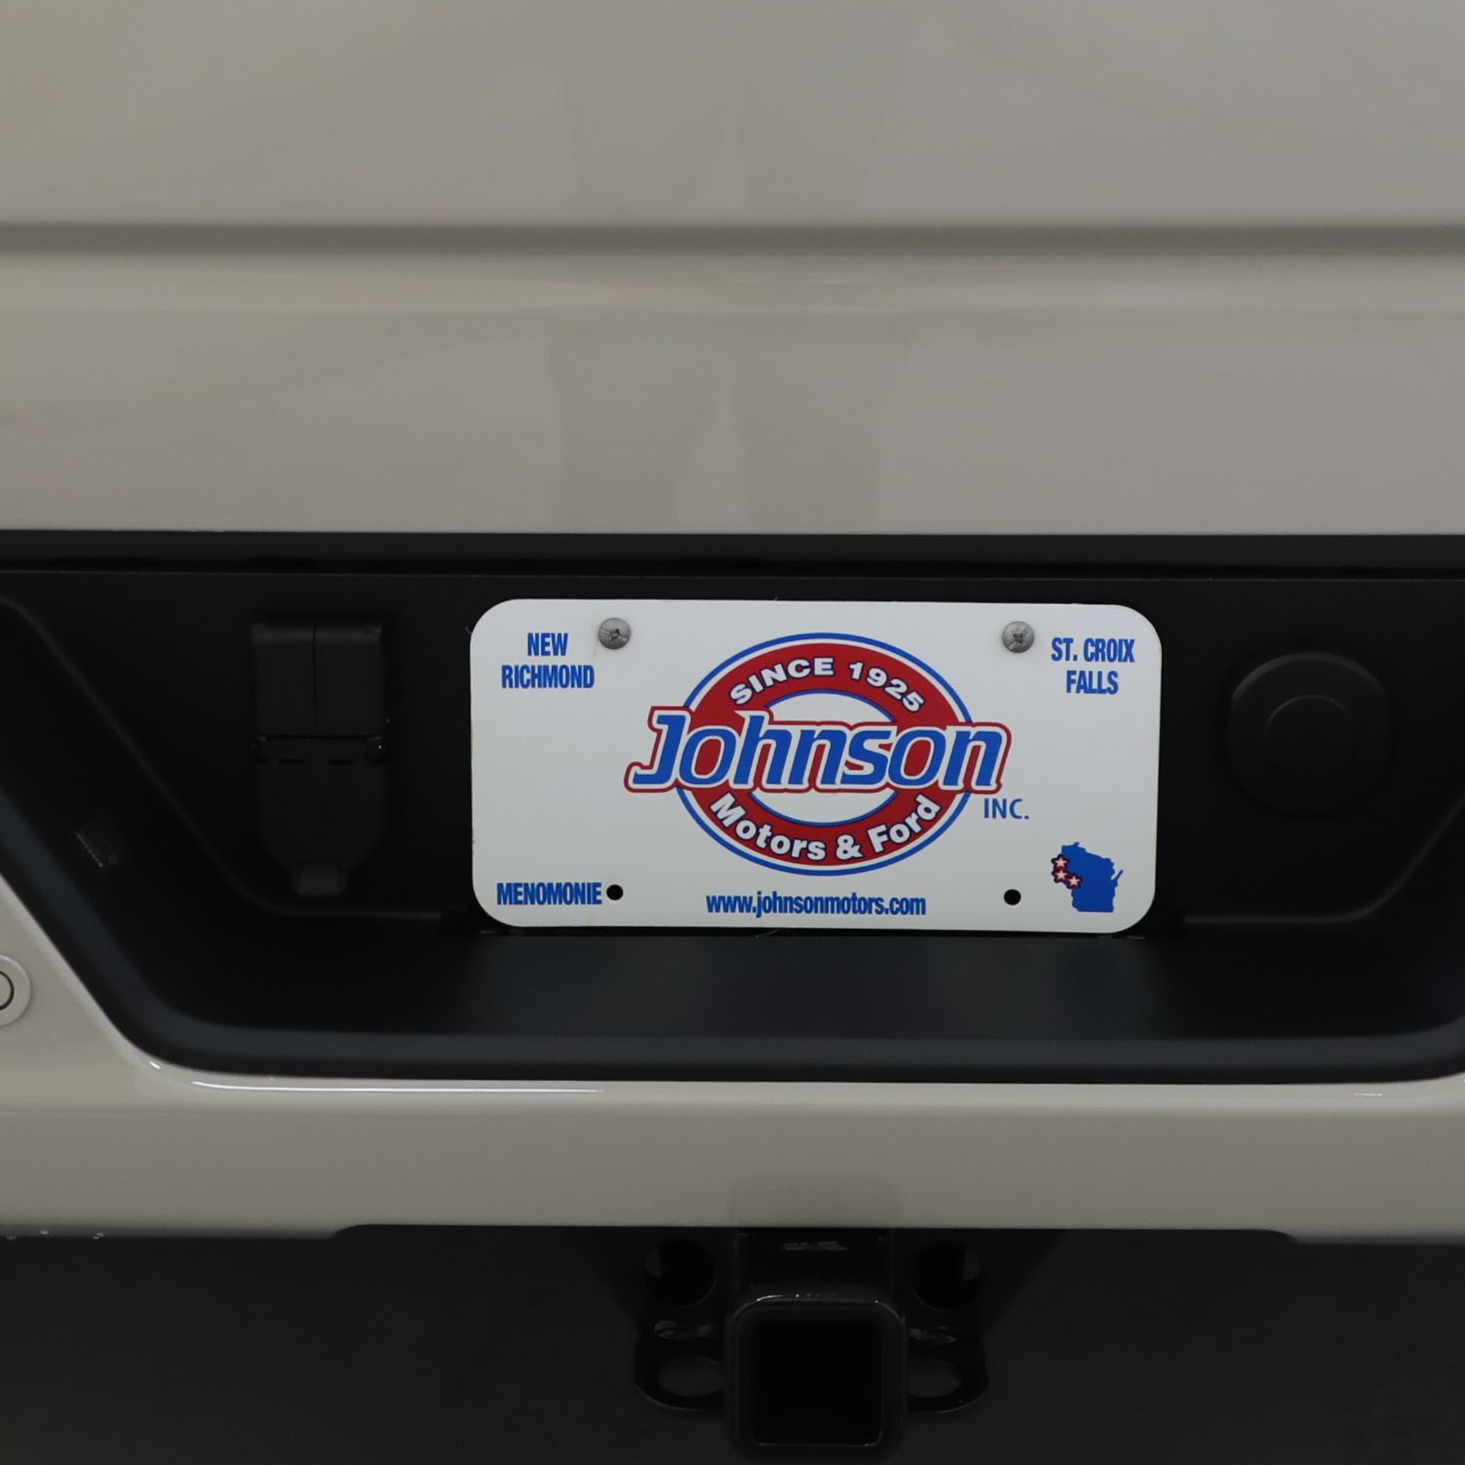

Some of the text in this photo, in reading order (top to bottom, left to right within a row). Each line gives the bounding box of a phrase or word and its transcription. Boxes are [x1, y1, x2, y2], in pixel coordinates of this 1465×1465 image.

[526, 632, 570, 657] NEW
[1050, 637, 1136, 663] ST. CROIX
[500, 664, 596, 689] RICHMOND
[728, 655, 925, 714] SINCE 1925
[1065, 670, 1120, 695] FALLS
[628, 708, 1008, 792] Johnson
[983, 797, 1031, 820] INC.
[709, 792, 941, 862] Motors & Ford
[496, 882, 603, 907] MENOMONIE
[705, 890, 927, 917] www.johnsonmotors.com
